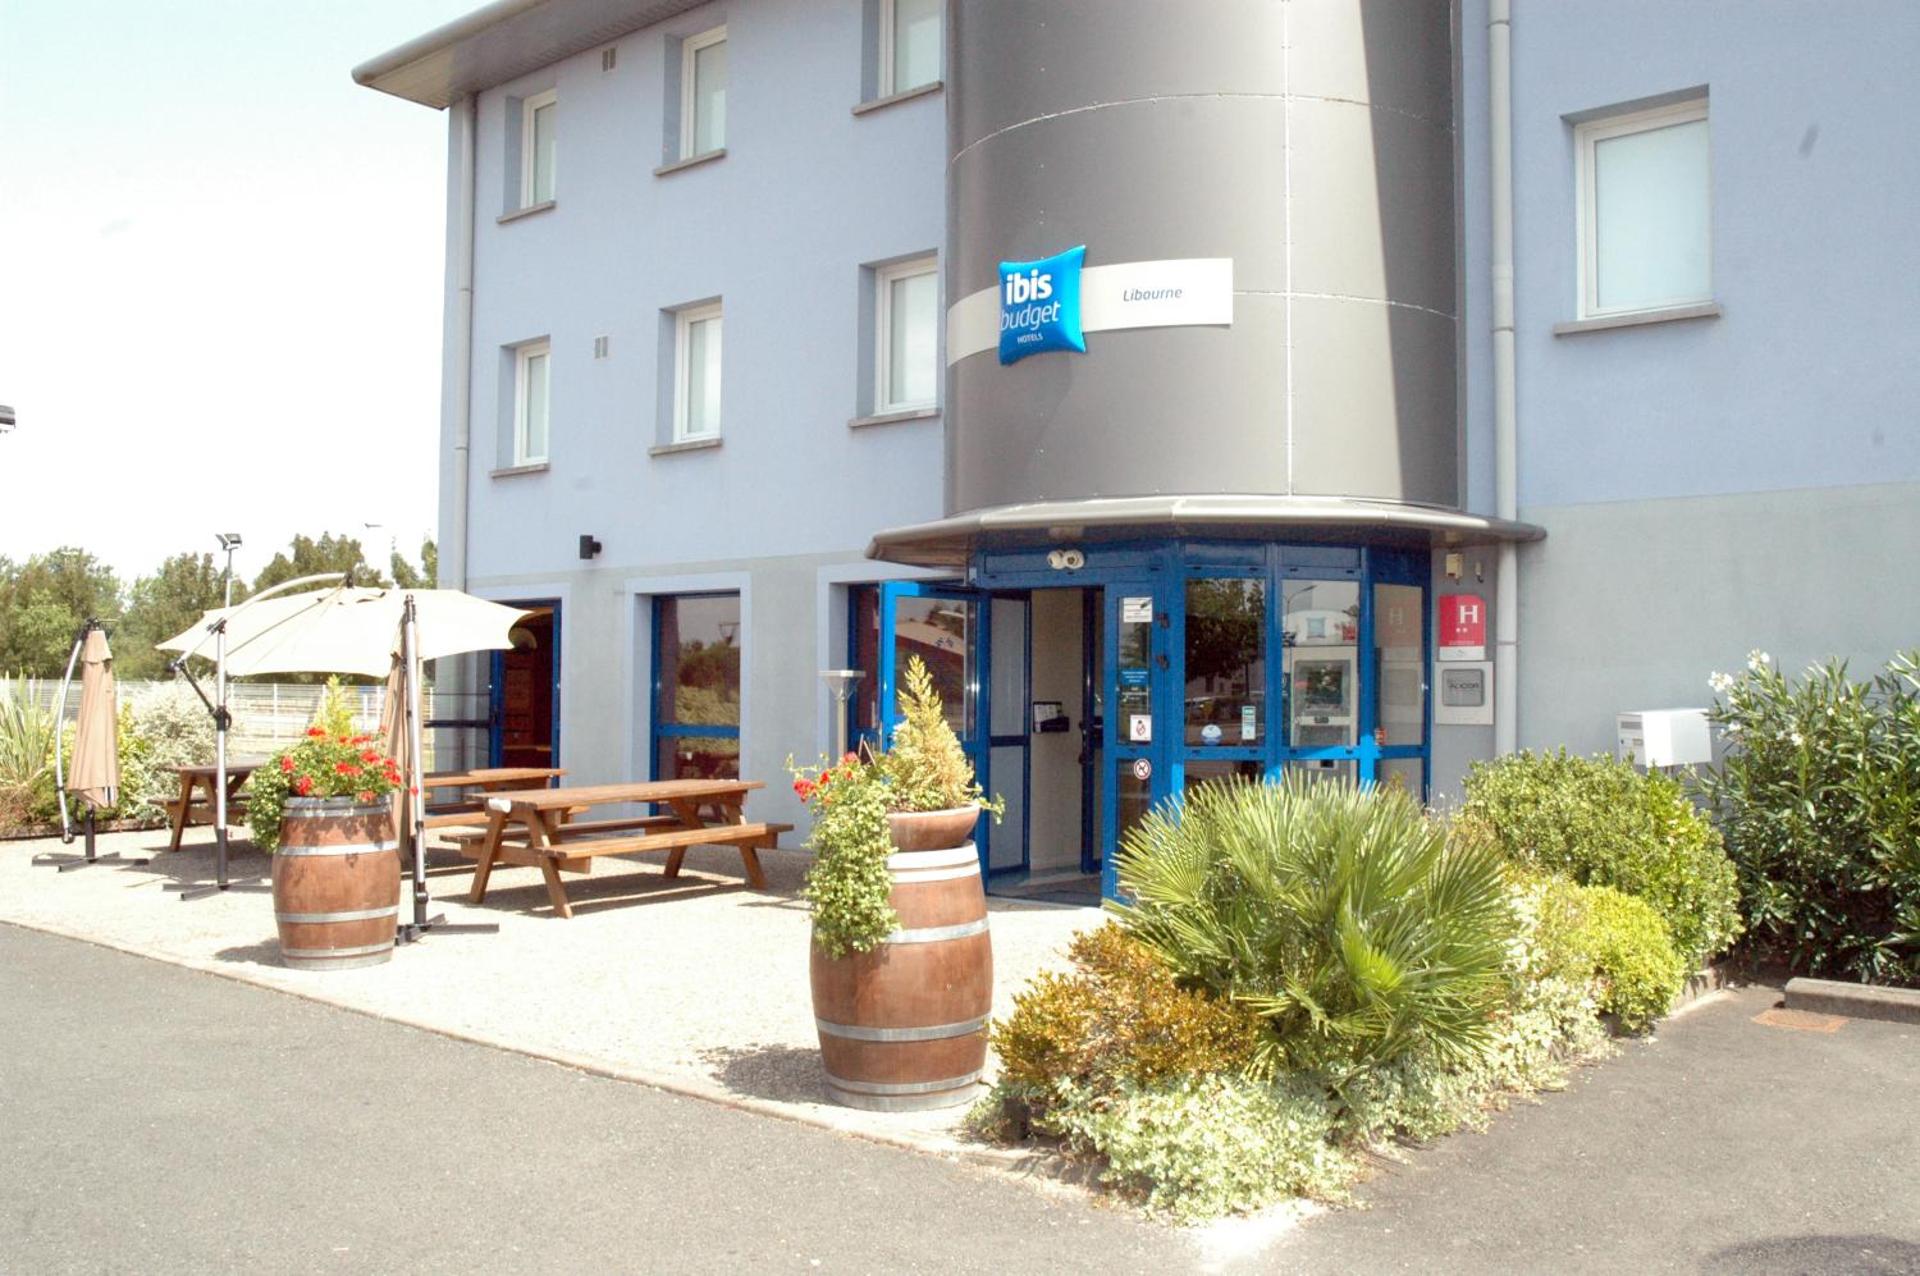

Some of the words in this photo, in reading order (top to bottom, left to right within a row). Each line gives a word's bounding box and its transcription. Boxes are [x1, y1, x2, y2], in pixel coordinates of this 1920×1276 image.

[1006, 268, 1053, 305] ibis
[1123, 288, 1183, 302] Libourne
[1000, 300, 1061, 331] budget
[1017, 333, 1043, 344] HOTELS
[1459, 605, 1478, 624] H
